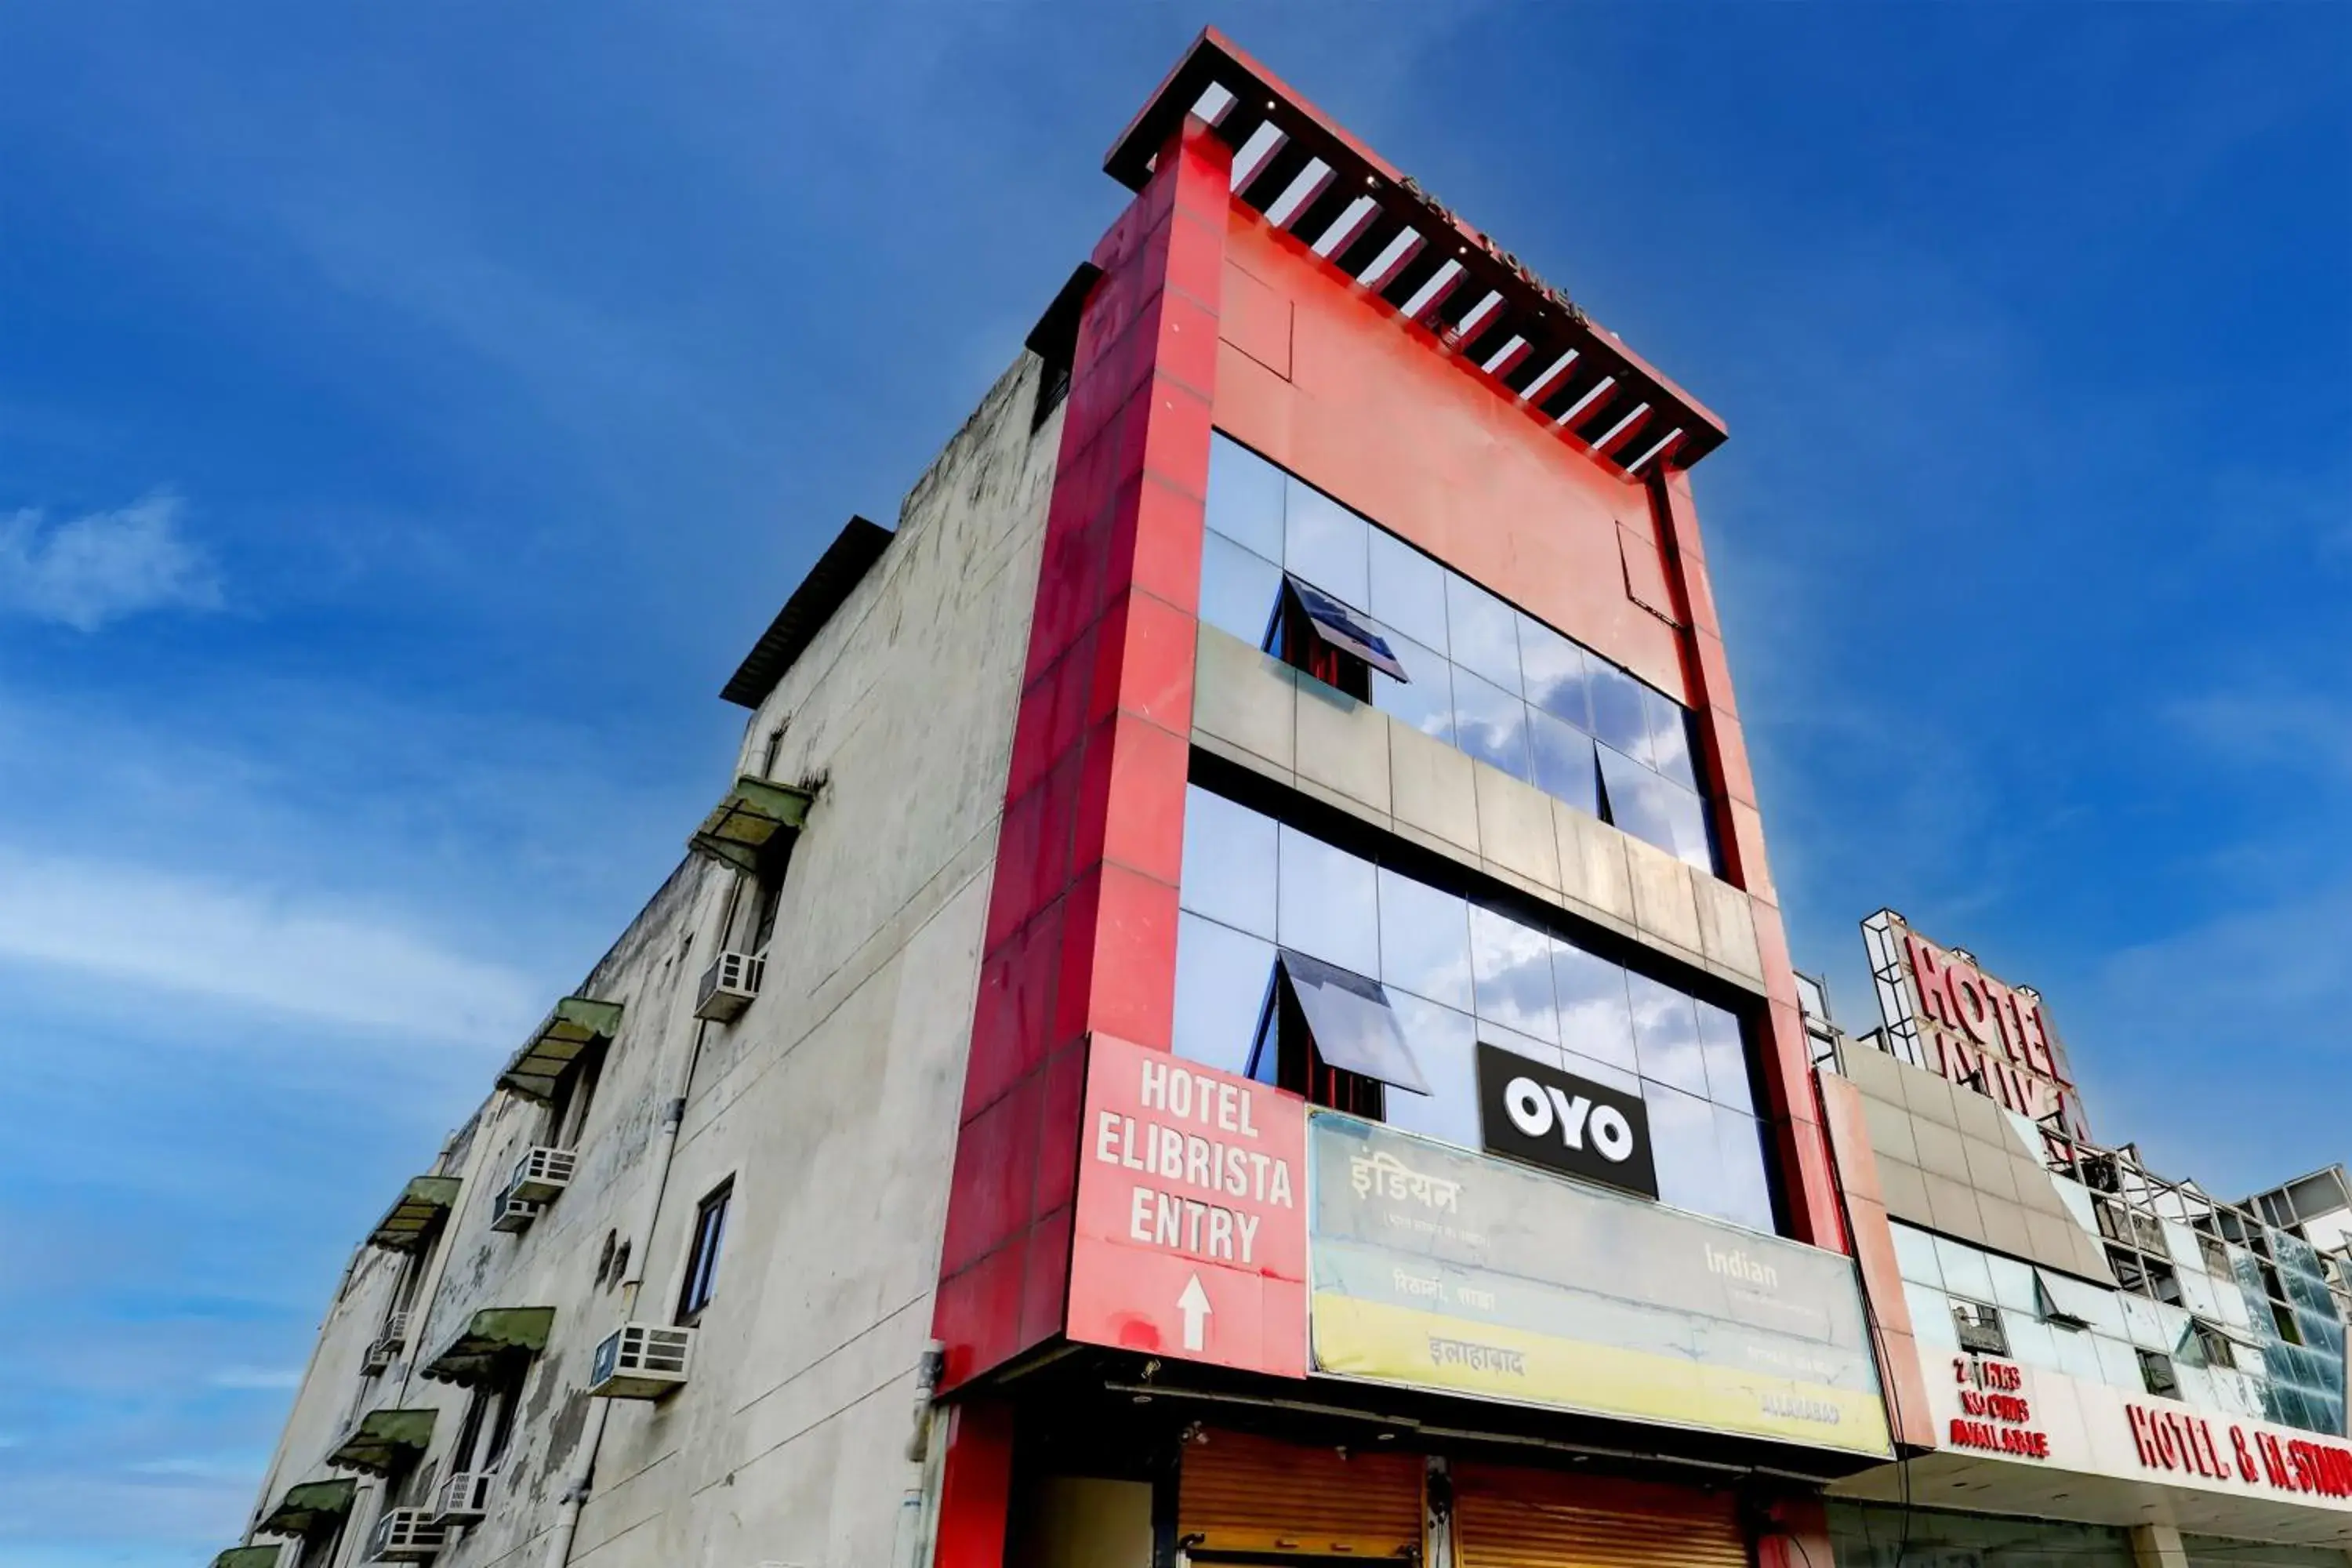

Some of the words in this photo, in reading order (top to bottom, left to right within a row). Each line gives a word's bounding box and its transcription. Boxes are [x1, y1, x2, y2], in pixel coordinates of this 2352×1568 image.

[1904, 933, 2074, 1091] HOTEL
[1142, 1059, 1259, 1138] HOTEL
[1504, 1076, 1633, 1163] OYO
[1097, 1111, 1293, 1208] ELIBRISTA
[1350, 1145, 1461, 1214] इंडियन
[1131, 1186, 1259, 1263] ENTRY
[1704, 1242, 1778, 1288] Indian
[1428, 1335, 1526, 1376] इलाहाबाद
[1949, 1418, 2050, 1459] AVAILABLE
[2125, 1403, 2232, 1480] HOTEL
[2229, 1425, 2259, 1483] &
